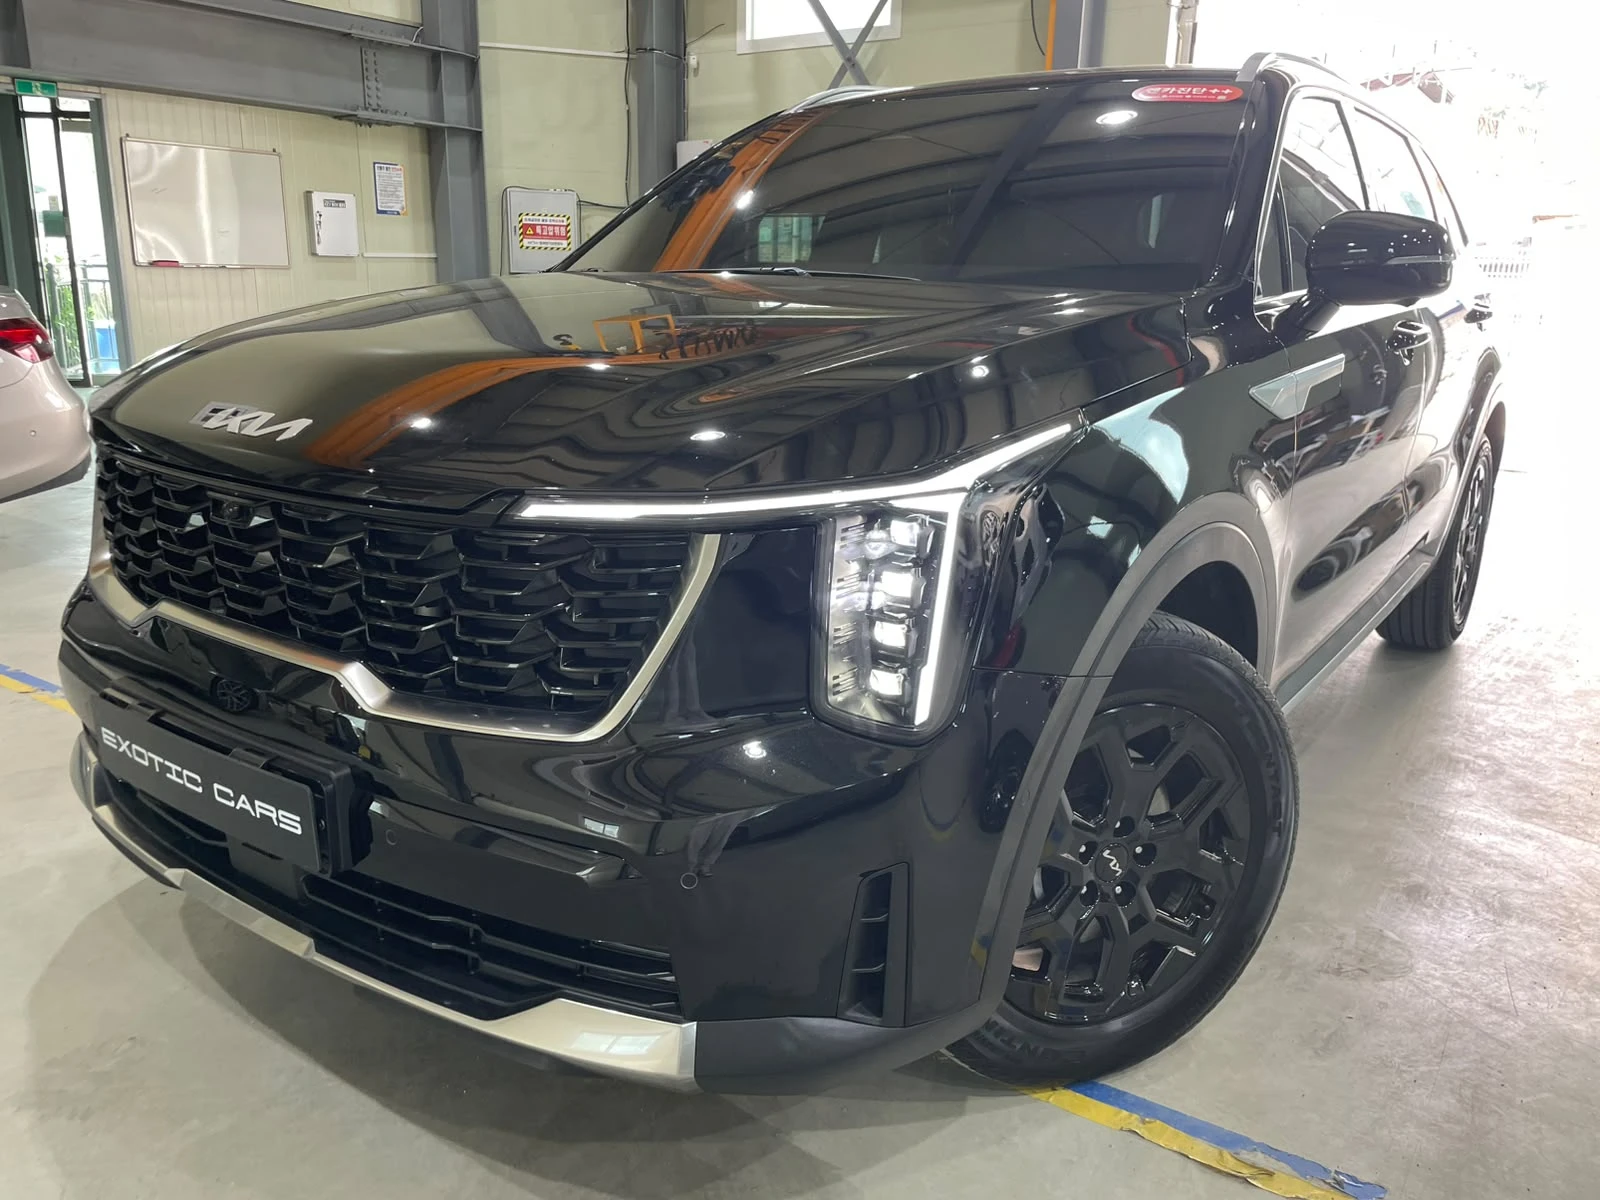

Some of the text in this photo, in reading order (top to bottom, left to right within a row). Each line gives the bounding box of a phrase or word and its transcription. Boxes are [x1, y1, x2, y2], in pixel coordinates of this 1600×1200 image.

[202, 407, 313, 441] KIA
[101, 726, 303, 836] EXOTIC CARS
